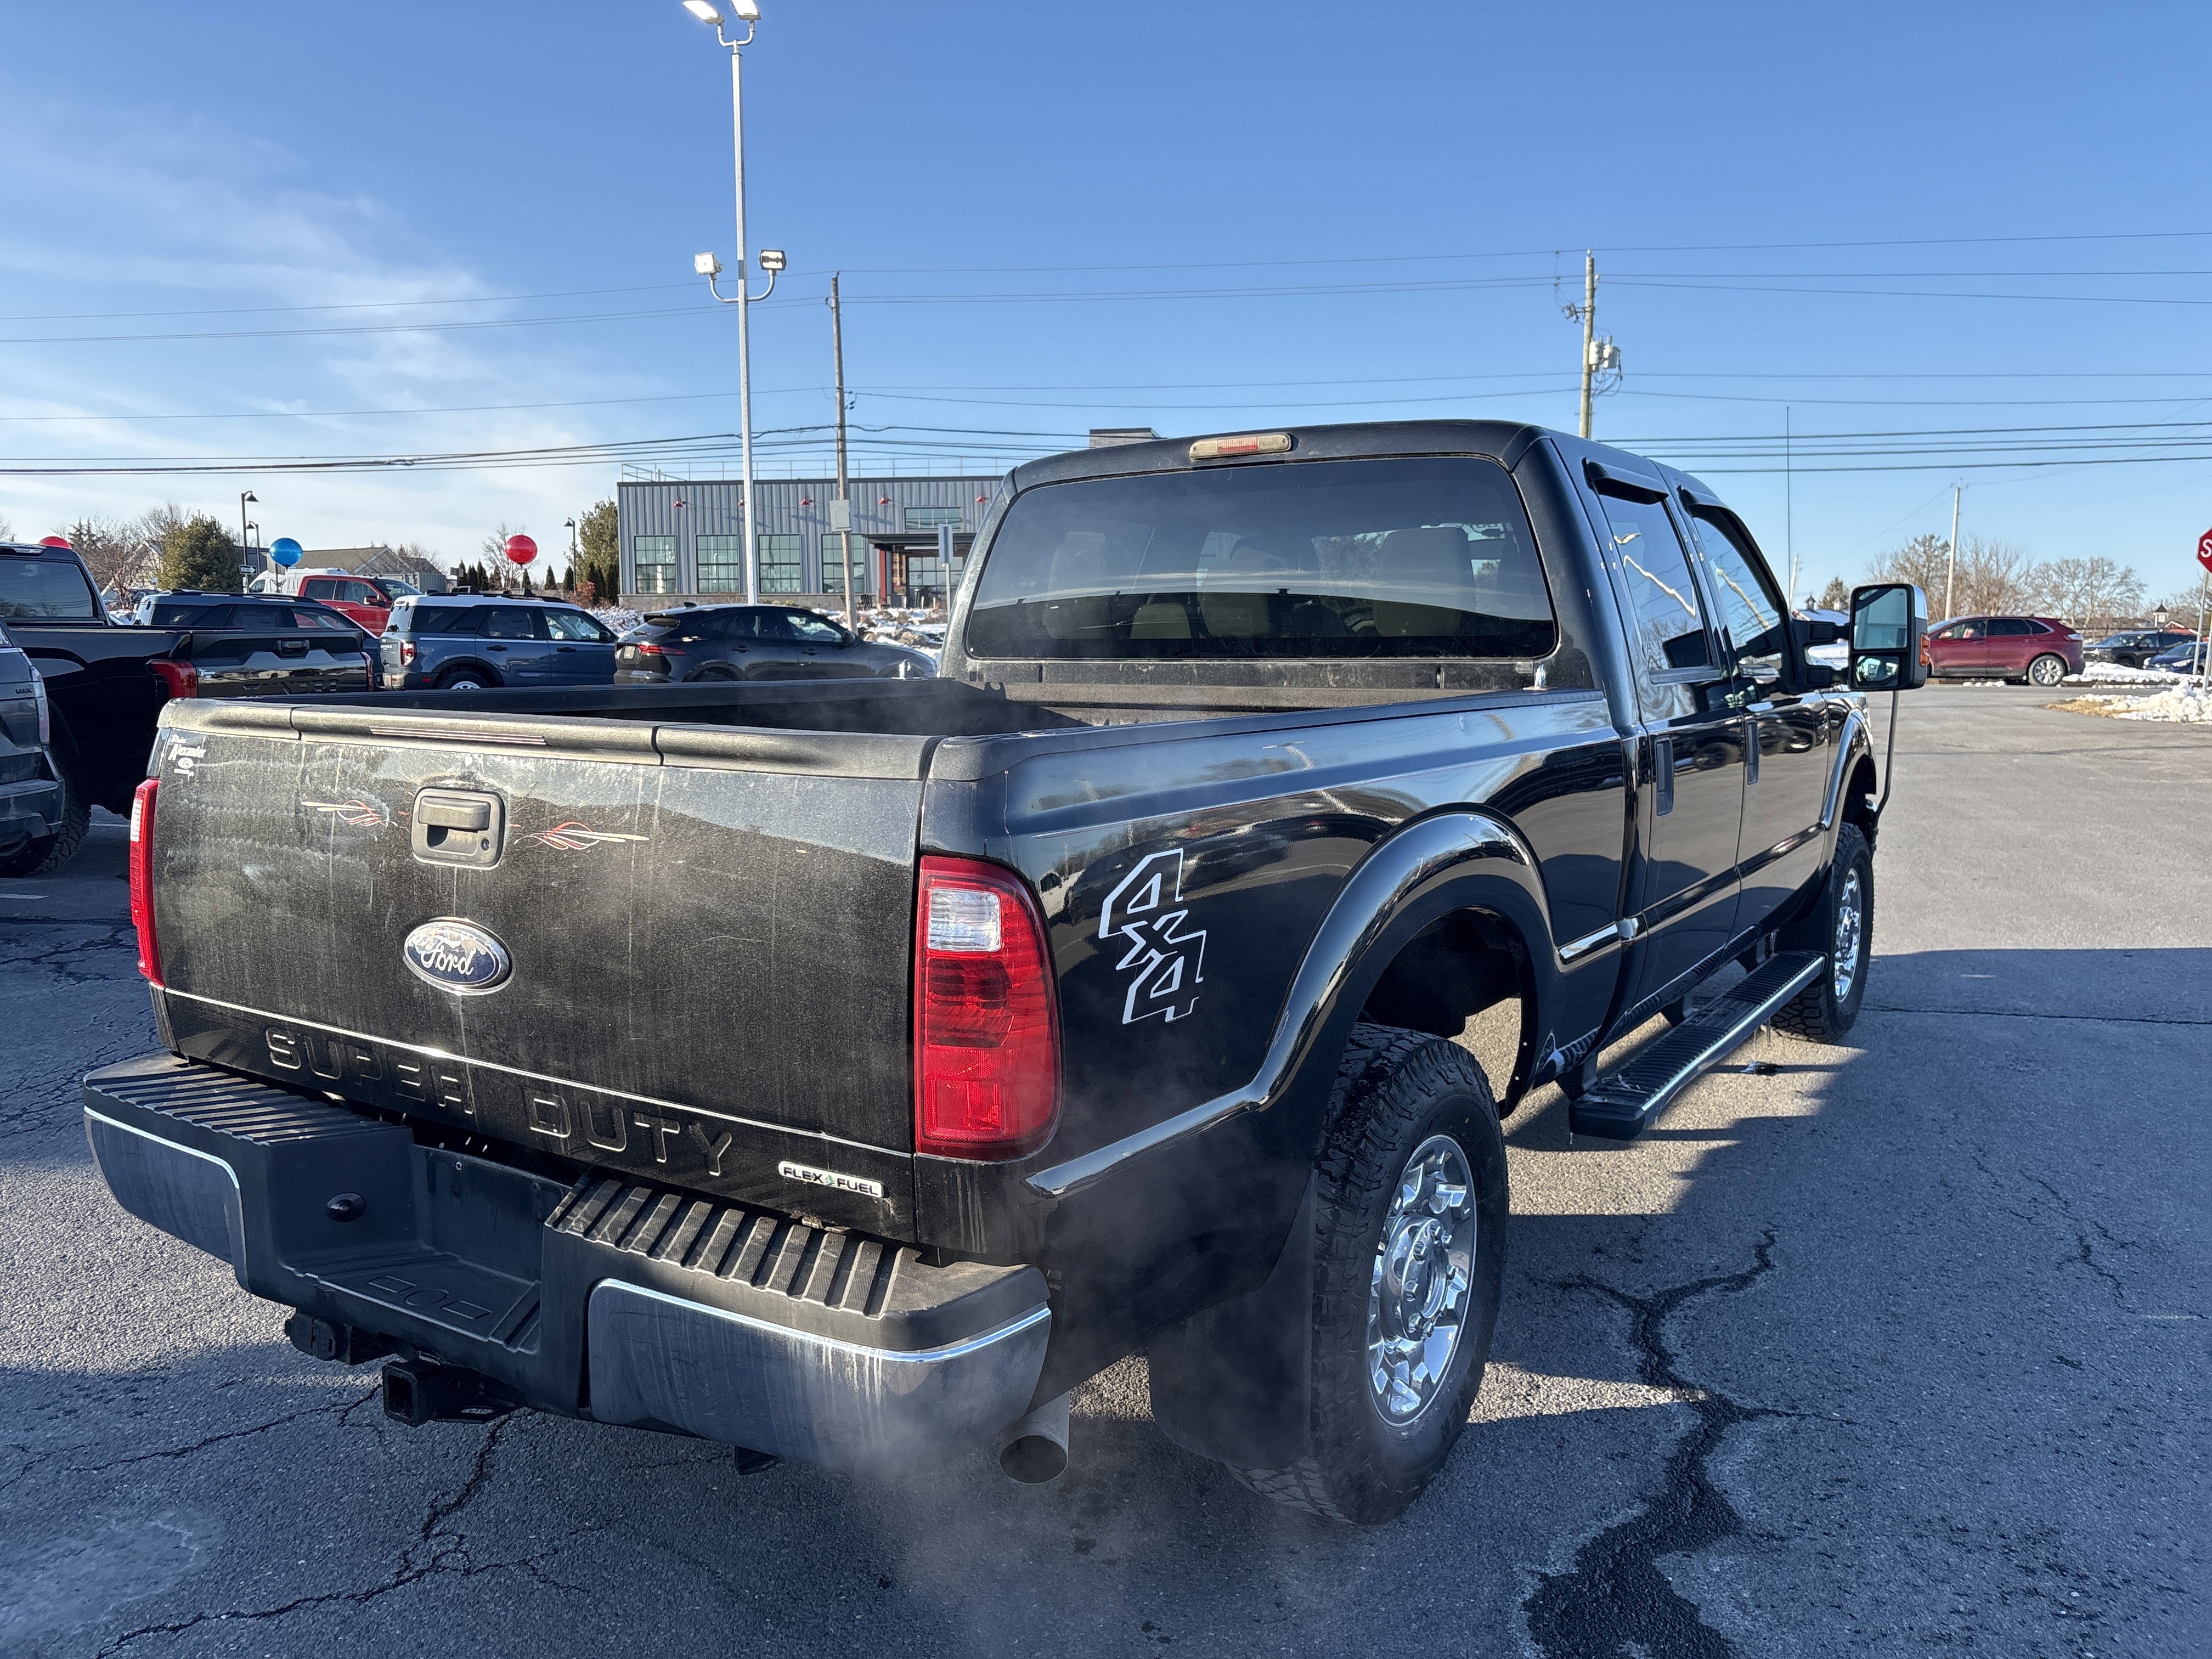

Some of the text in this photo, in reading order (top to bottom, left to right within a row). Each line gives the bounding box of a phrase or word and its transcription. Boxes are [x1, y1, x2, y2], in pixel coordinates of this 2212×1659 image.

[420, 935, 477, 975] Ford
[266, 1026, 732, 1176] SUPER DUTY
[783, 1166, 879, 1196] FLEX FUEL
